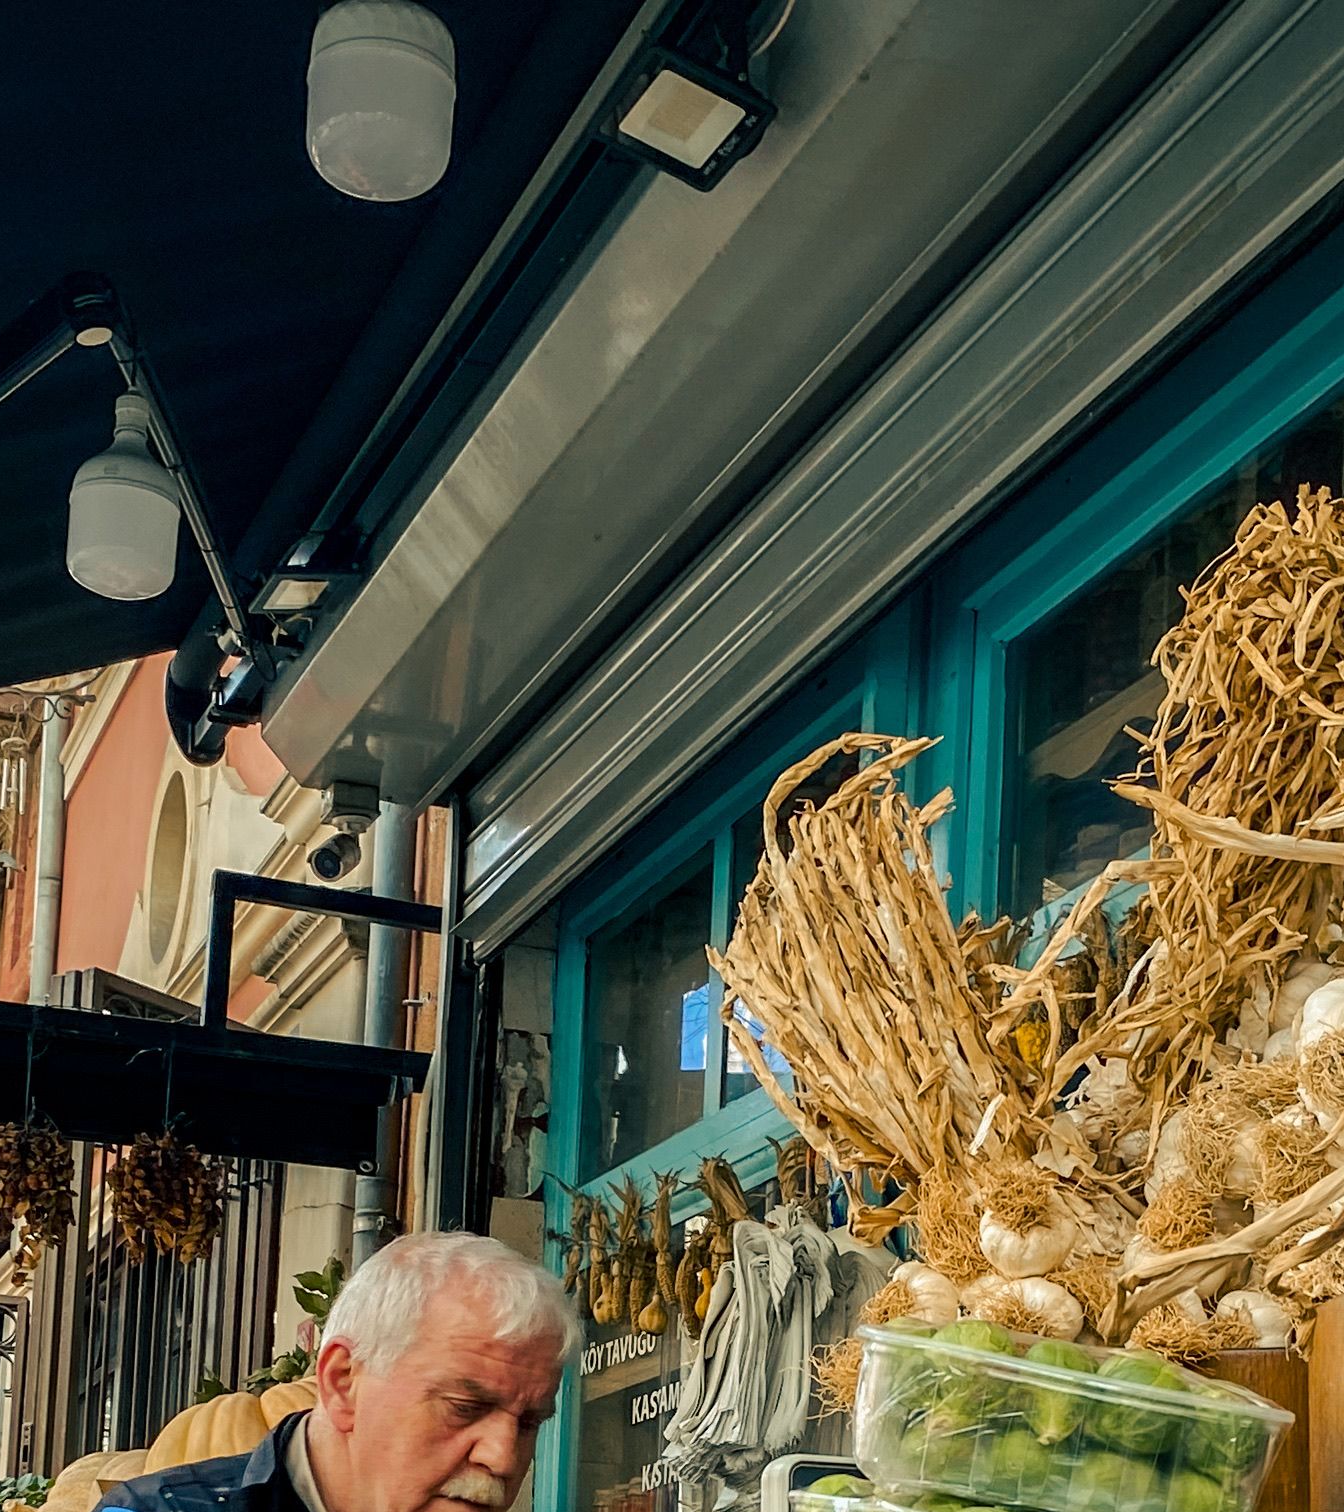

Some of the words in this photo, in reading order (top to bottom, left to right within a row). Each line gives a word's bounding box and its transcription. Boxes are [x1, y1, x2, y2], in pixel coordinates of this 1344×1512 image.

[580, 1341, 605, 1376] KÖY
[631, 1381, 682, 1425] KASTAM
[641, 1460, 680, 1492] KASTA
